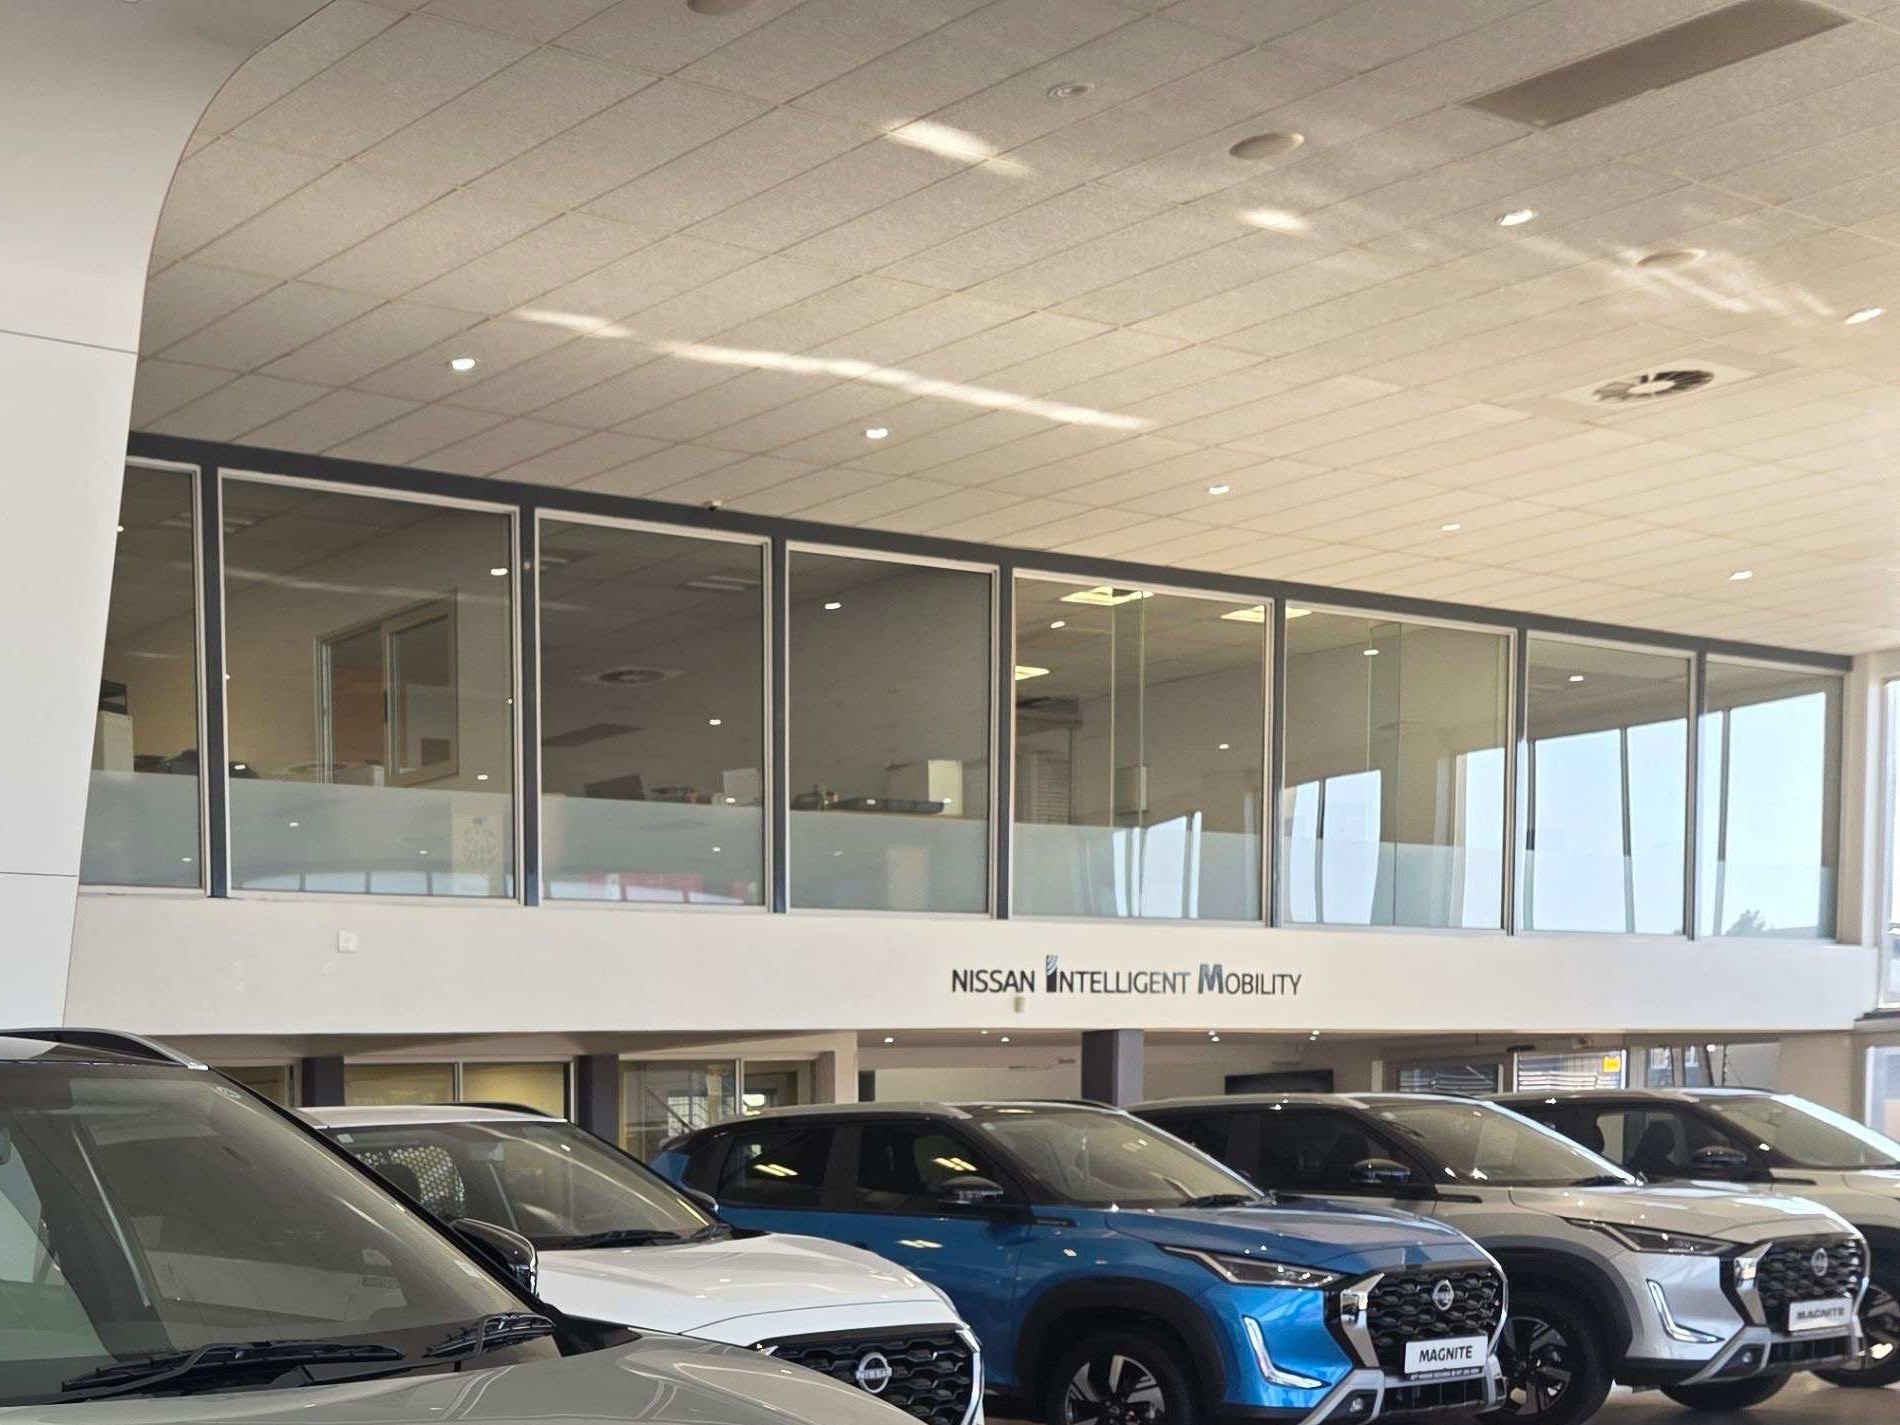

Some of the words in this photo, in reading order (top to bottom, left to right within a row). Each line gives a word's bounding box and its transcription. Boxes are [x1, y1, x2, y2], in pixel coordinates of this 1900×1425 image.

[952, 969, 1035, 993] NISSAN
[1046, 954, 1191, 994] INTELLIGENT
[1197, 963, 1302, 995] MOBILITY
[1418, 1345, 1473, 1363] MAGNITE
